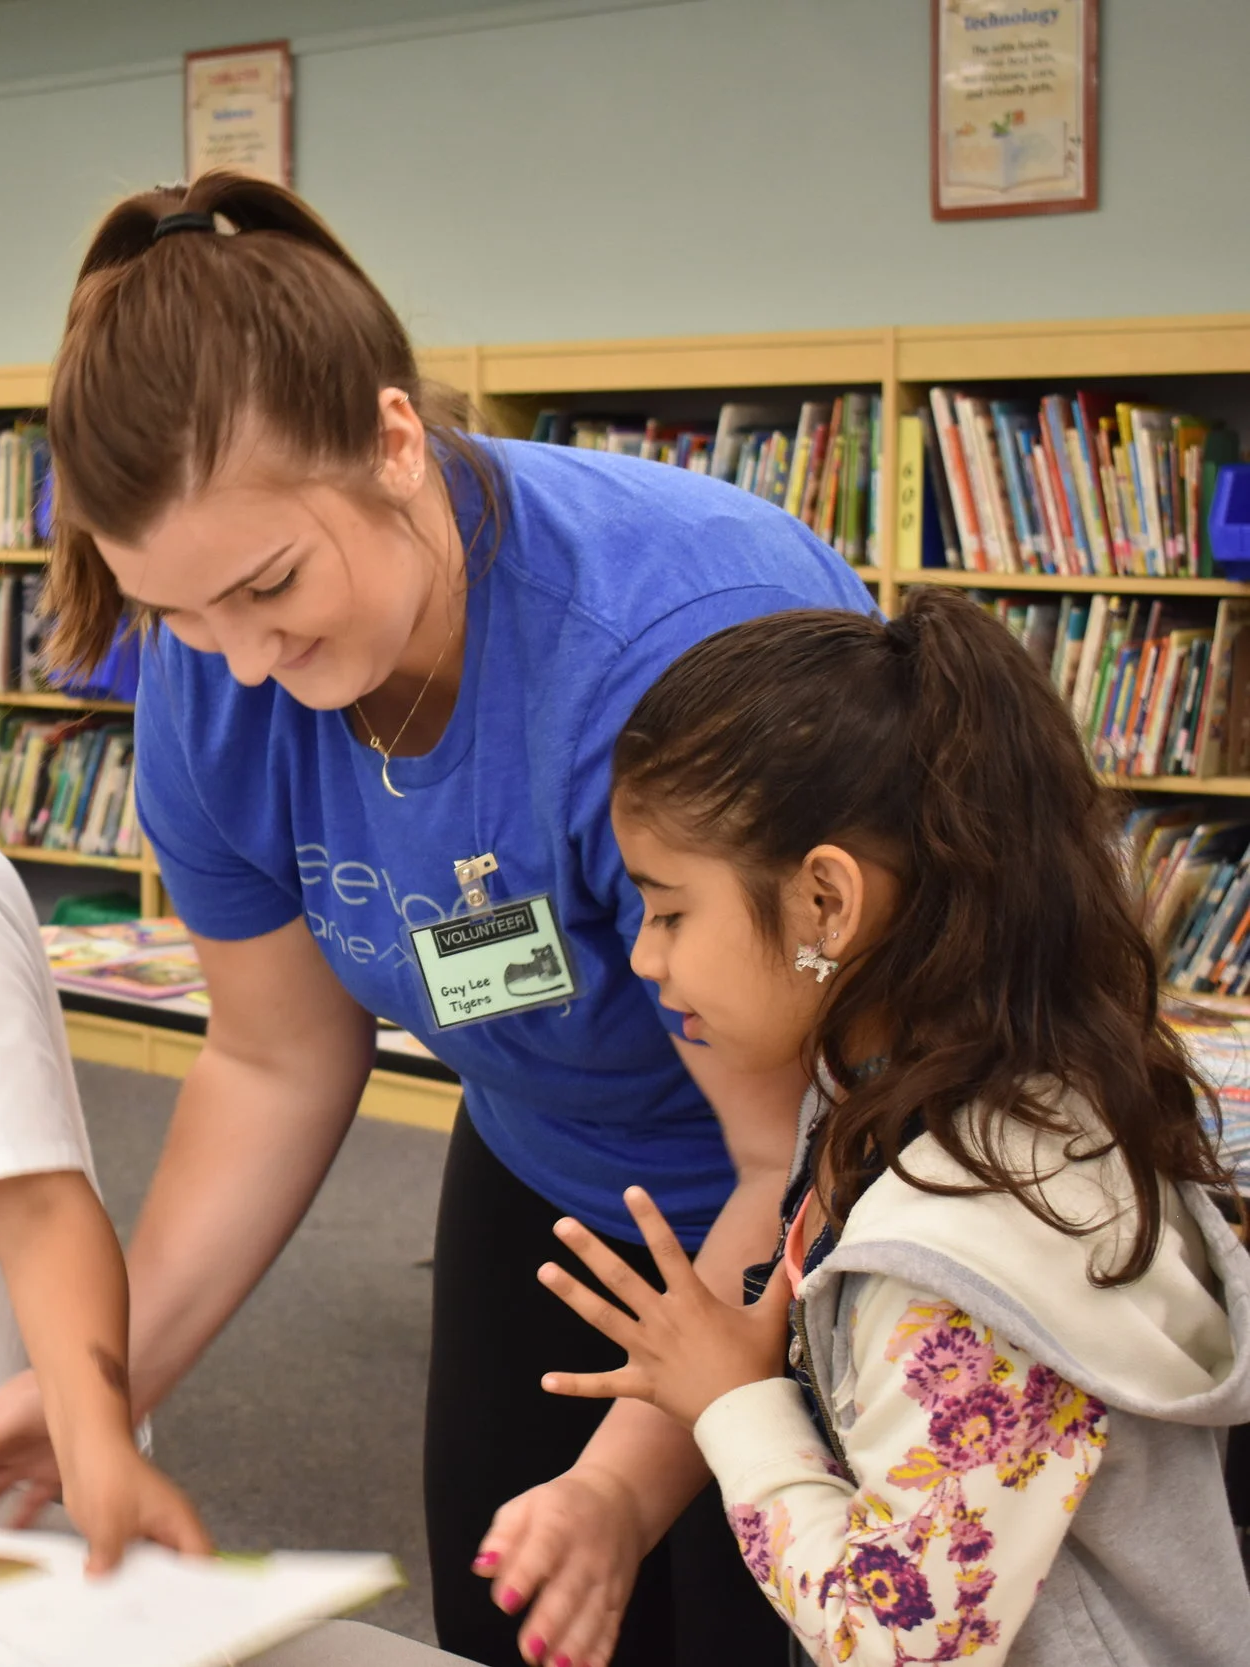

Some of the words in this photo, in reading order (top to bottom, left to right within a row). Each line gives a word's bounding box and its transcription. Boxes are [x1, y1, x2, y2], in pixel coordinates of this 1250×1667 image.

[963, 7, 1060, 32] Technology
[440, 913, 527, 946] VOLUNTEER
[441, 983, 466, 998] Guy
[468, 977, 491, 991] Lee
[449, 993, 492, 1014] Tigers
